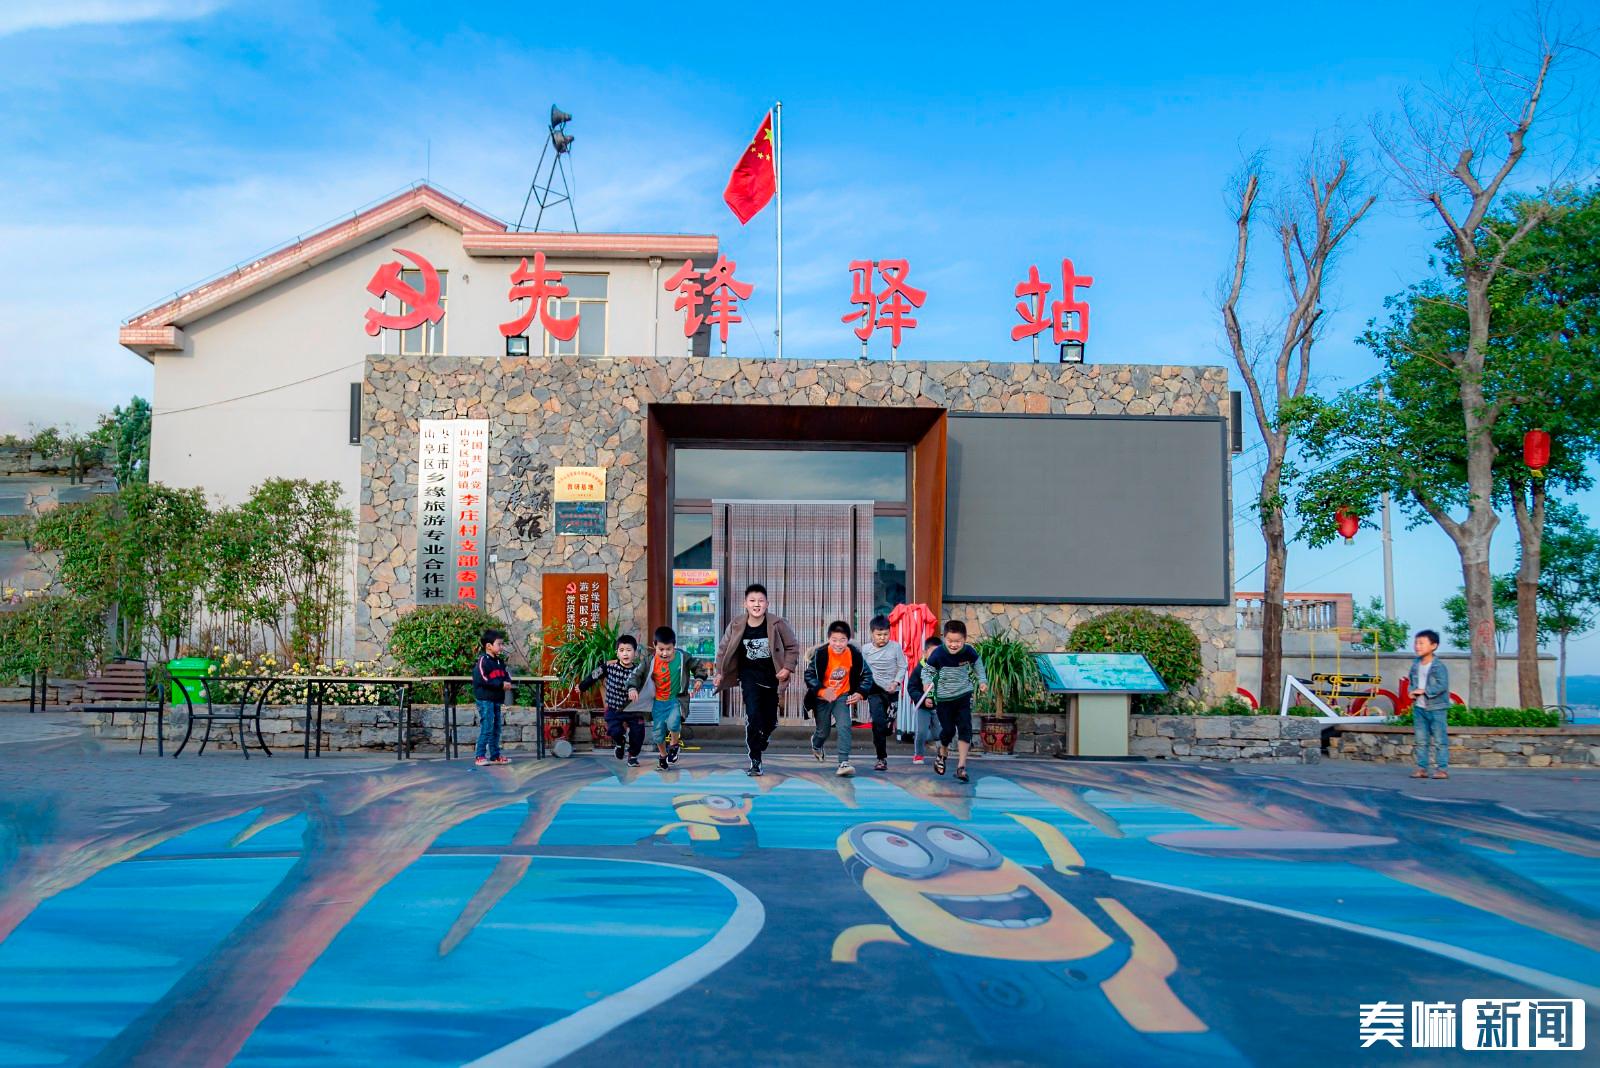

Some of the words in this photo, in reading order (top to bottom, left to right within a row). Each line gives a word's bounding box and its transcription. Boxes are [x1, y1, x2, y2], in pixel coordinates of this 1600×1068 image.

[499, 251, 1094, 349] 先锋驿站
[422, 472, 446, 598] 乡缘旅游专业合作社
[579, 581, 589, 640] 游客服务
